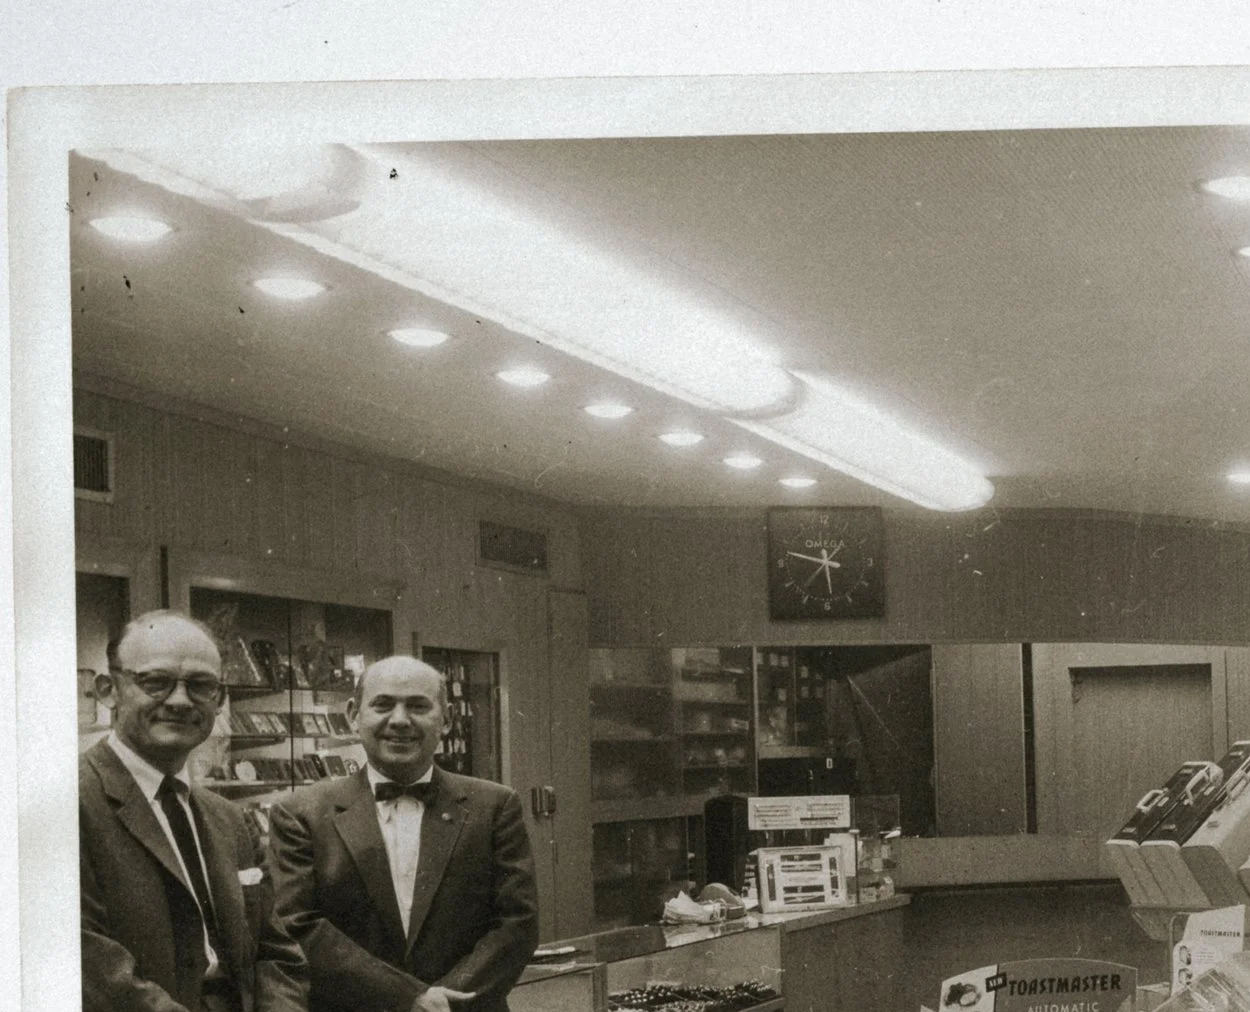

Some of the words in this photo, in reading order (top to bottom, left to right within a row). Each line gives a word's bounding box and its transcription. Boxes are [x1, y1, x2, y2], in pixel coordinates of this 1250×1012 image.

[805, 539, 845, 549] OMEGA
[824, 602, 831, 611] 6
[1008, 974, 1121, 996] TOASTMASTER
